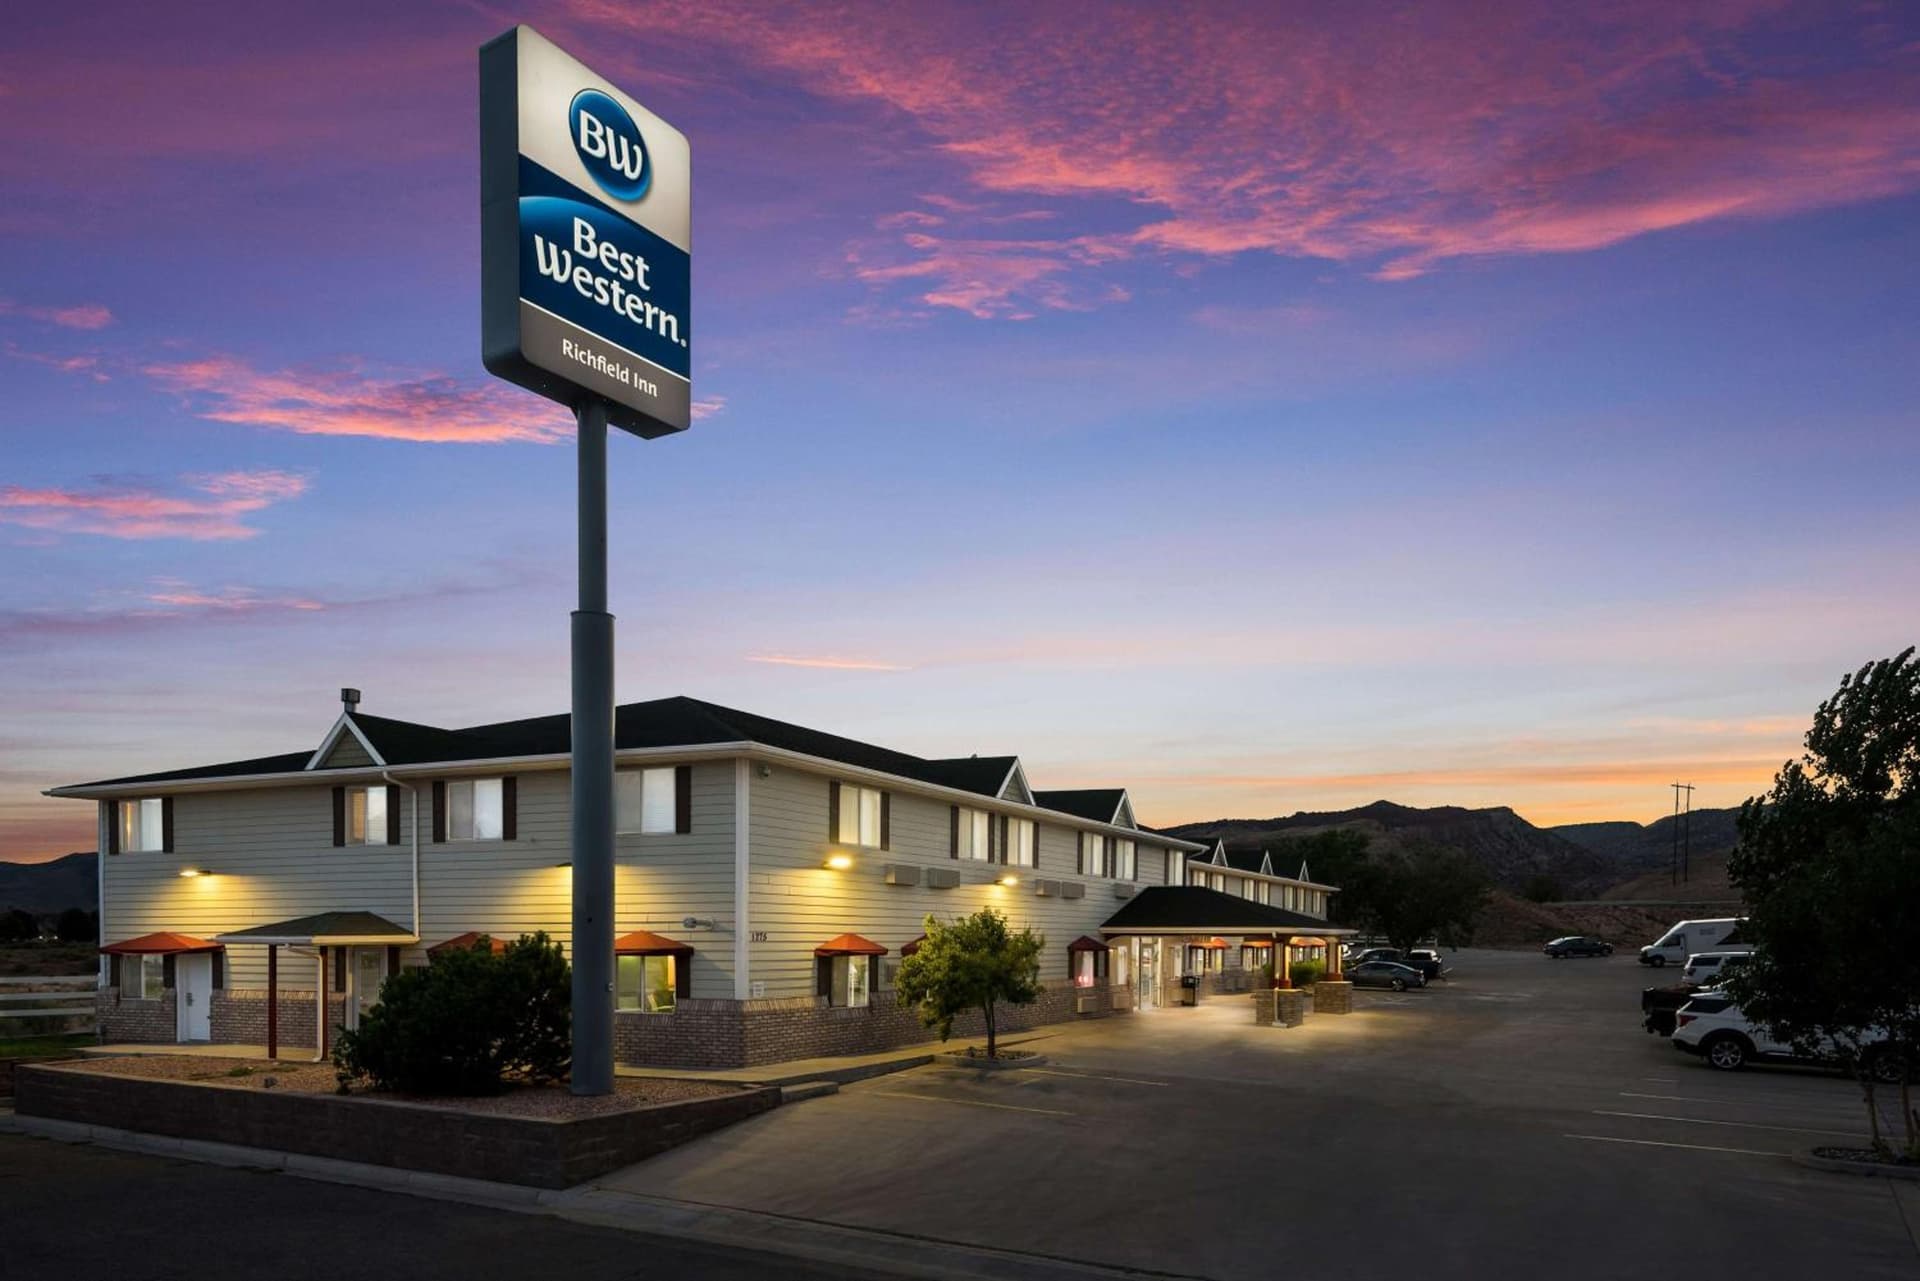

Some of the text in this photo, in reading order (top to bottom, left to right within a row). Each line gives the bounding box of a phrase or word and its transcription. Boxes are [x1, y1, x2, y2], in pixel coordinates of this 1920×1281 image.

[579, 109, 643, 180] BW
[573, 216, 650, 291] Best
[562, 338, 658, 397] Richfield Inn
